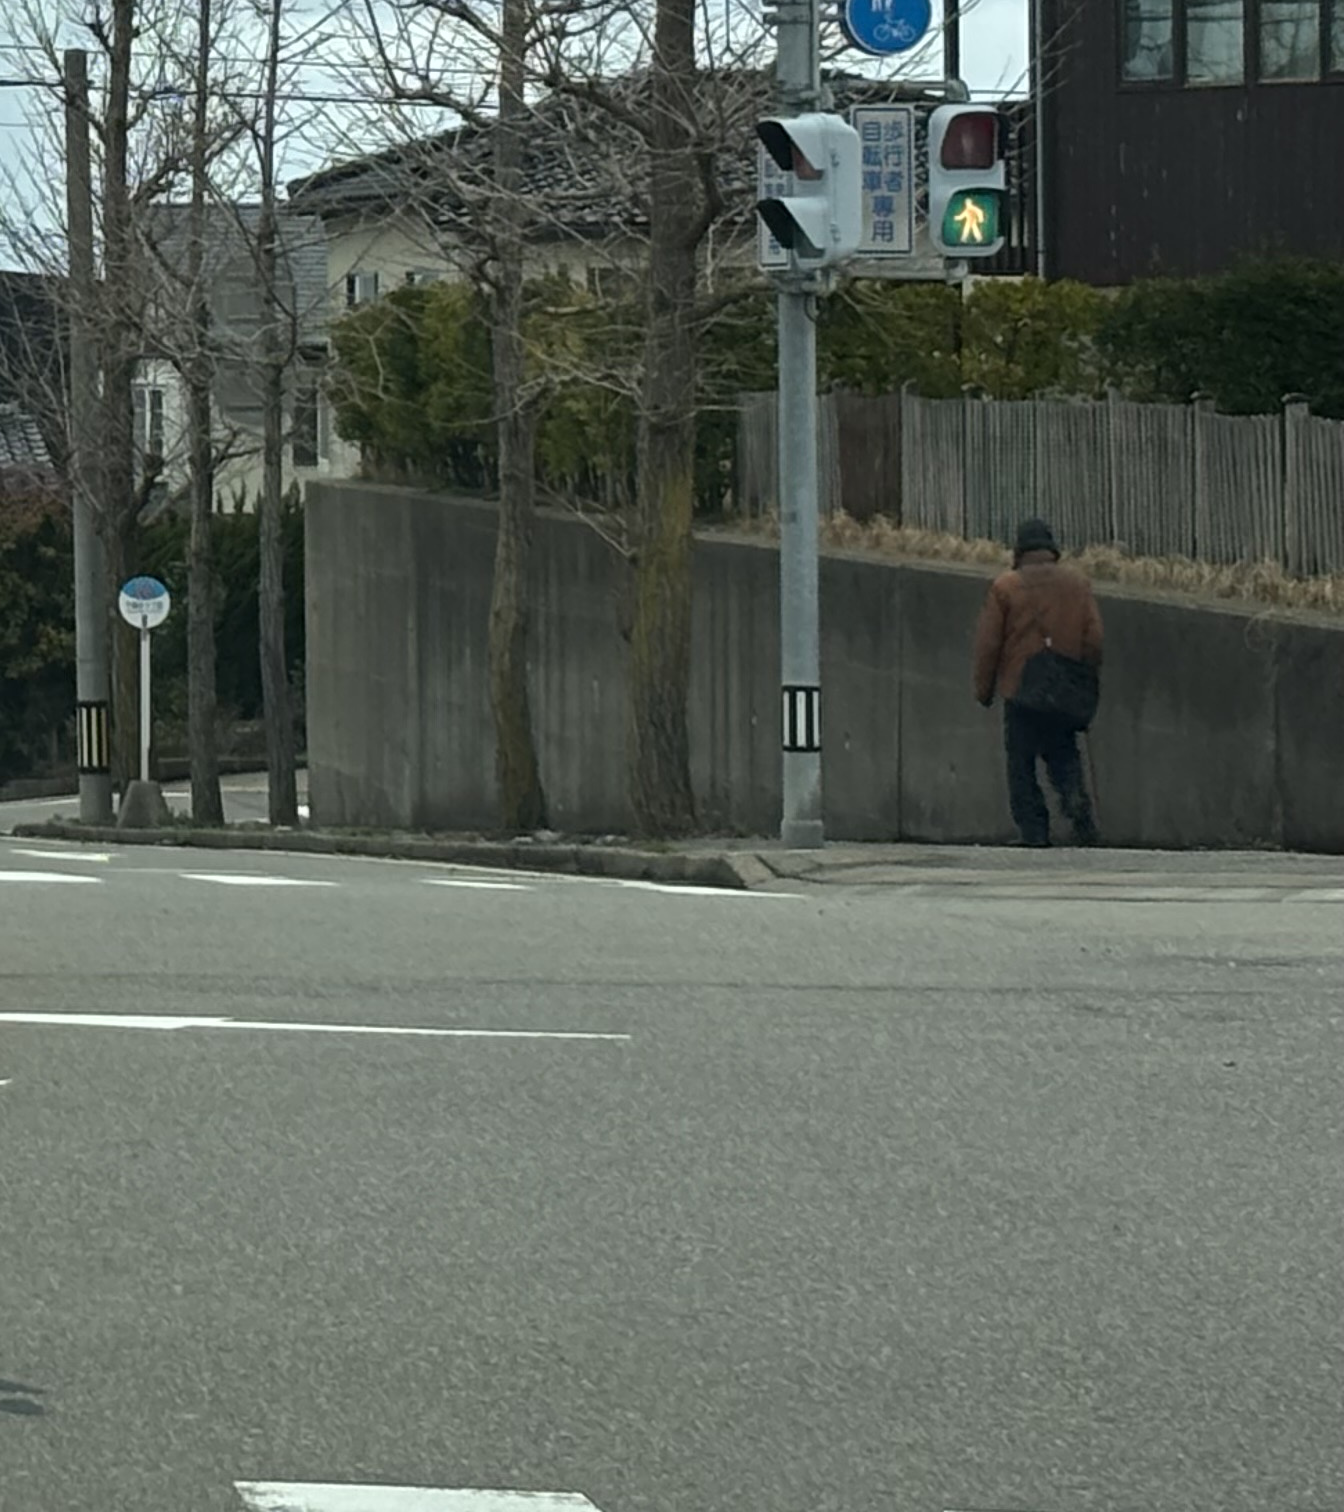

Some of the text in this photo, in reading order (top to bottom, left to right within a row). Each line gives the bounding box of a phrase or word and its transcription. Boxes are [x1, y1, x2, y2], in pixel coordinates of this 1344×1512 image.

[862, 121, 882, 192] 自転車
[883, 120, 905, 192] 歩行者
[872, 195, 895, 242] 専用
